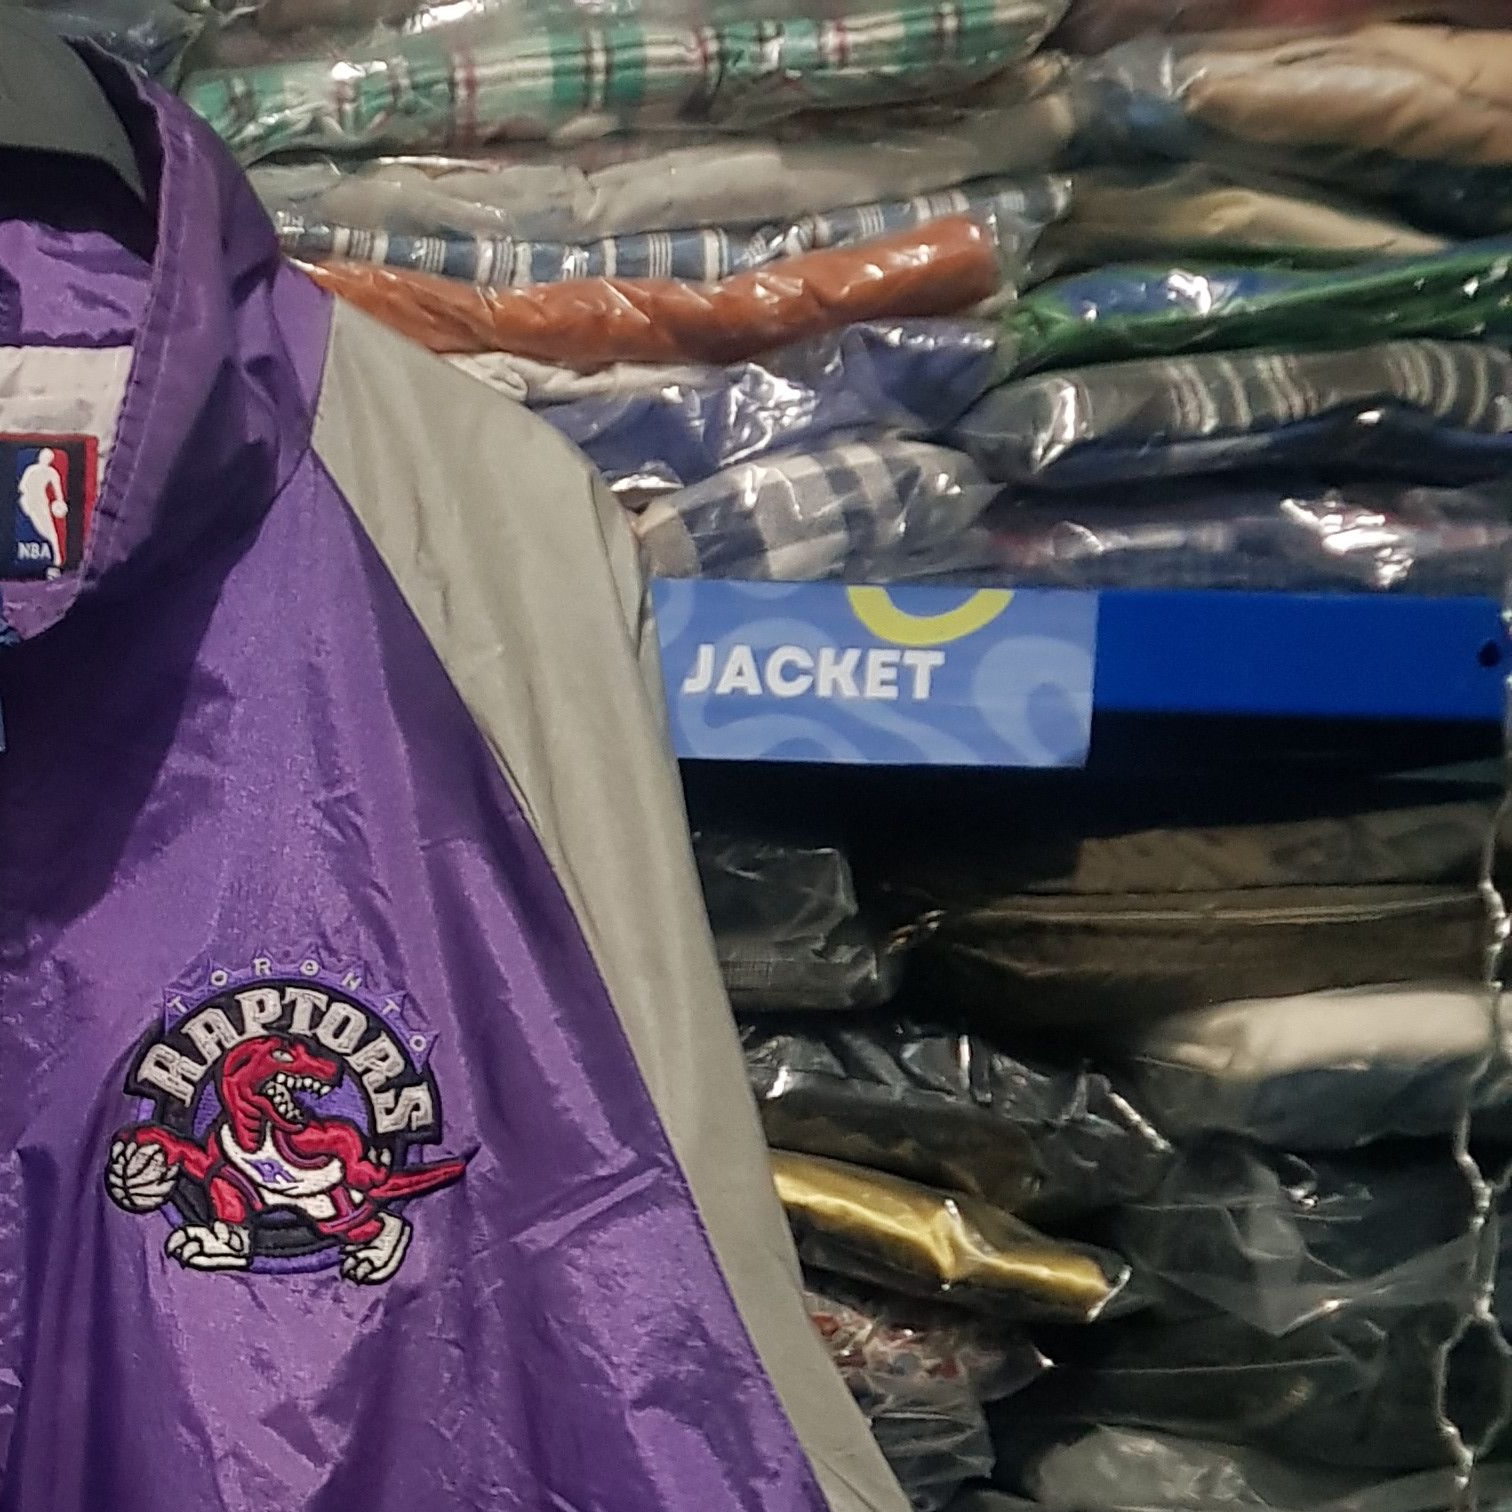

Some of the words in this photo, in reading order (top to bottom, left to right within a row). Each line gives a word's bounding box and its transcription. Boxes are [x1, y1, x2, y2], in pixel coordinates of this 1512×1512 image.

[17, 542, 61, 560] NBA
[683, 643, 946, 699] JACKET
[168, 957, 428, 1052] TORONTO
[138, 986, 434, 1134] RAPTORS
